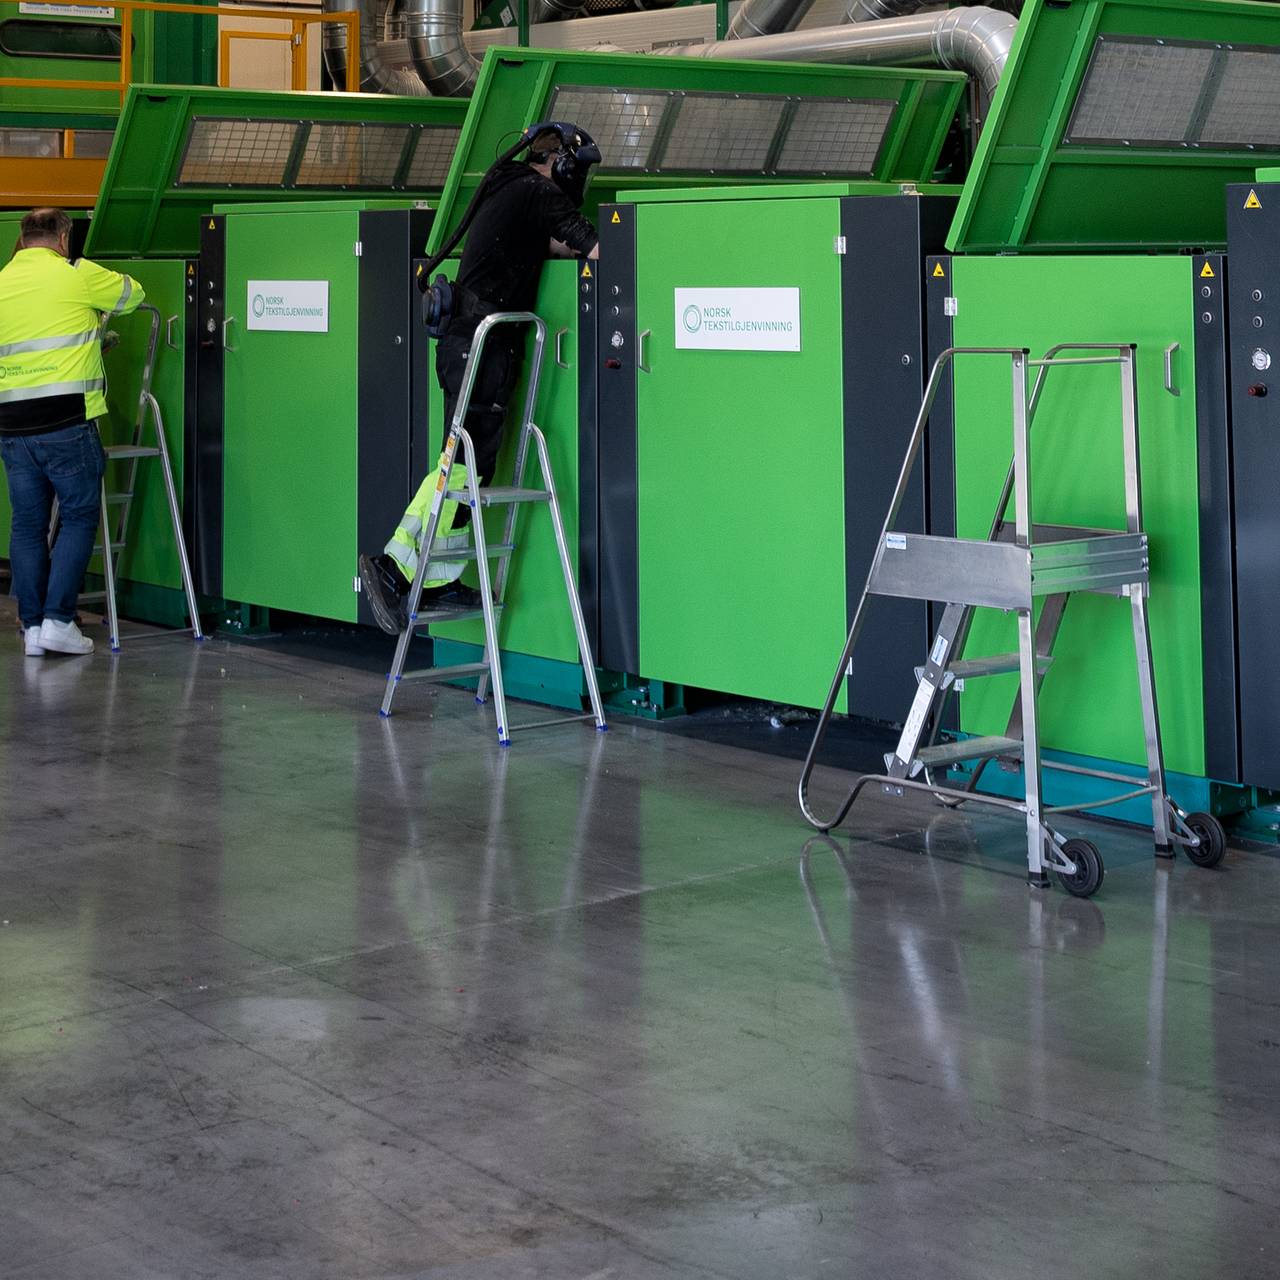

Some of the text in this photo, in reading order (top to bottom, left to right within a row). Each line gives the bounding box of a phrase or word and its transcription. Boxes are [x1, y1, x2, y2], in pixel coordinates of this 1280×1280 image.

[265, 297, 285, 305] NORSK
[703, 307, 732, 318] NORSK
[703, 320, 793, 332] TEKSTILGJENVINNING
